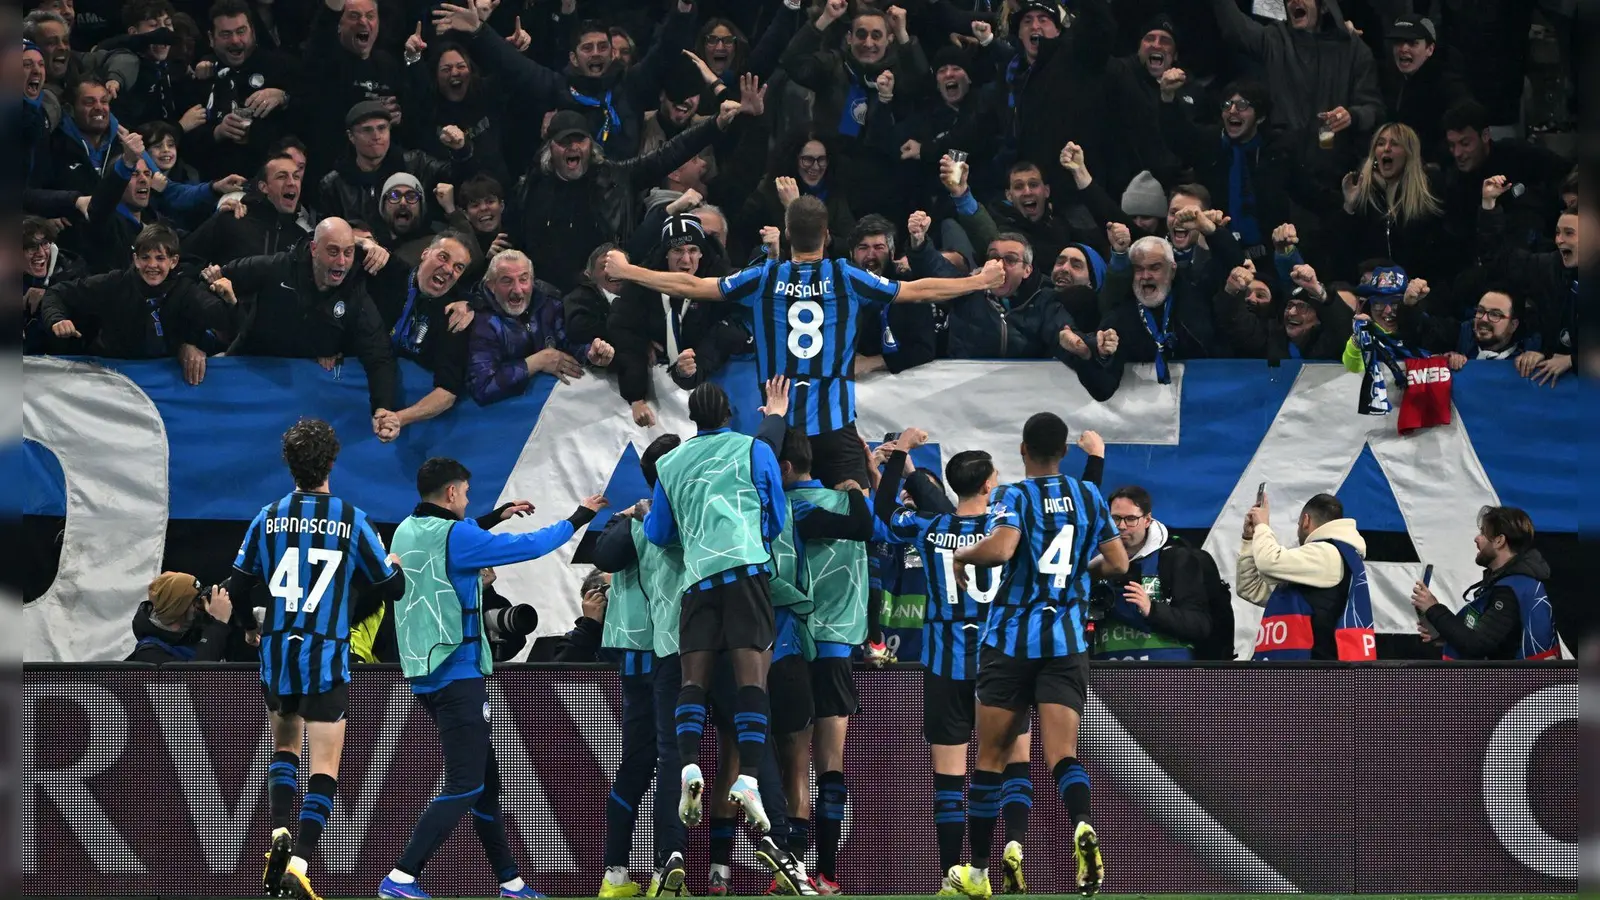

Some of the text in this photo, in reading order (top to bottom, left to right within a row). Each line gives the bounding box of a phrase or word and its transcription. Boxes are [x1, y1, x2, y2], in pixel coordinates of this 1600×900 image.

[775, 277, 832, 299] PAŠALIĆ
[787, 300, 825, 360] 8
[1044, 496, 1074, 514] HIEN
[265, 517, 352, 539] BERNASCONI
[934, 547, 1003, 604] 10
[1038, 524, 1075, 589] 4
[268, 546, 343, 613] 47
[880, 598, 924, 620] HANN
